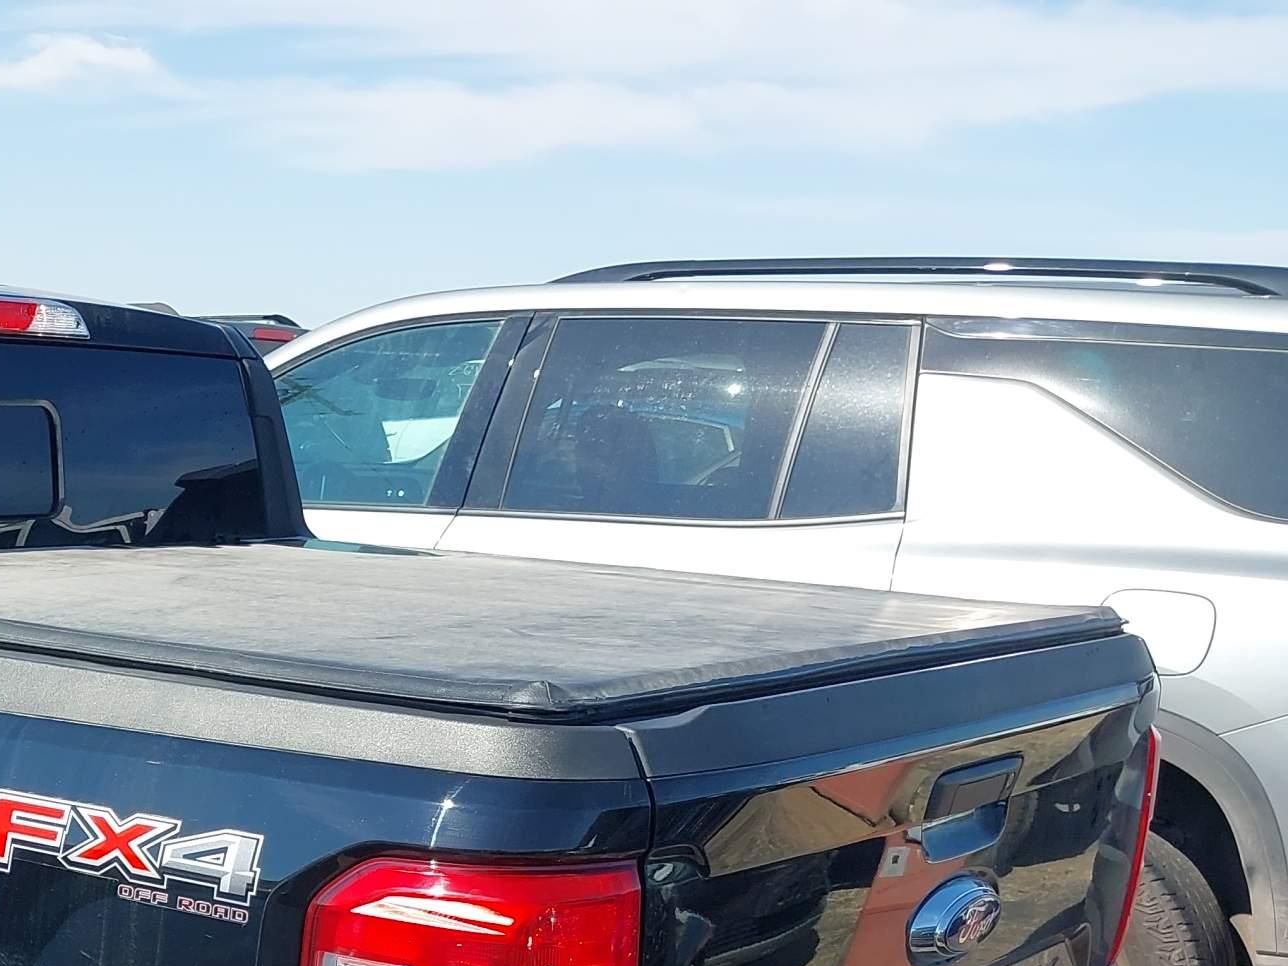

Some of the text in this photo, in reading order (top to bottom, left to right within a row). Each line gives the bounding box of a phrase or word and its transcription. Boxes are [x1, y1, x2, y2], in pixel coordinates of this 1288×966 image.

[116, 883, 250, 925] OFF ROAD
[957, 897, 996, 944] Ford
